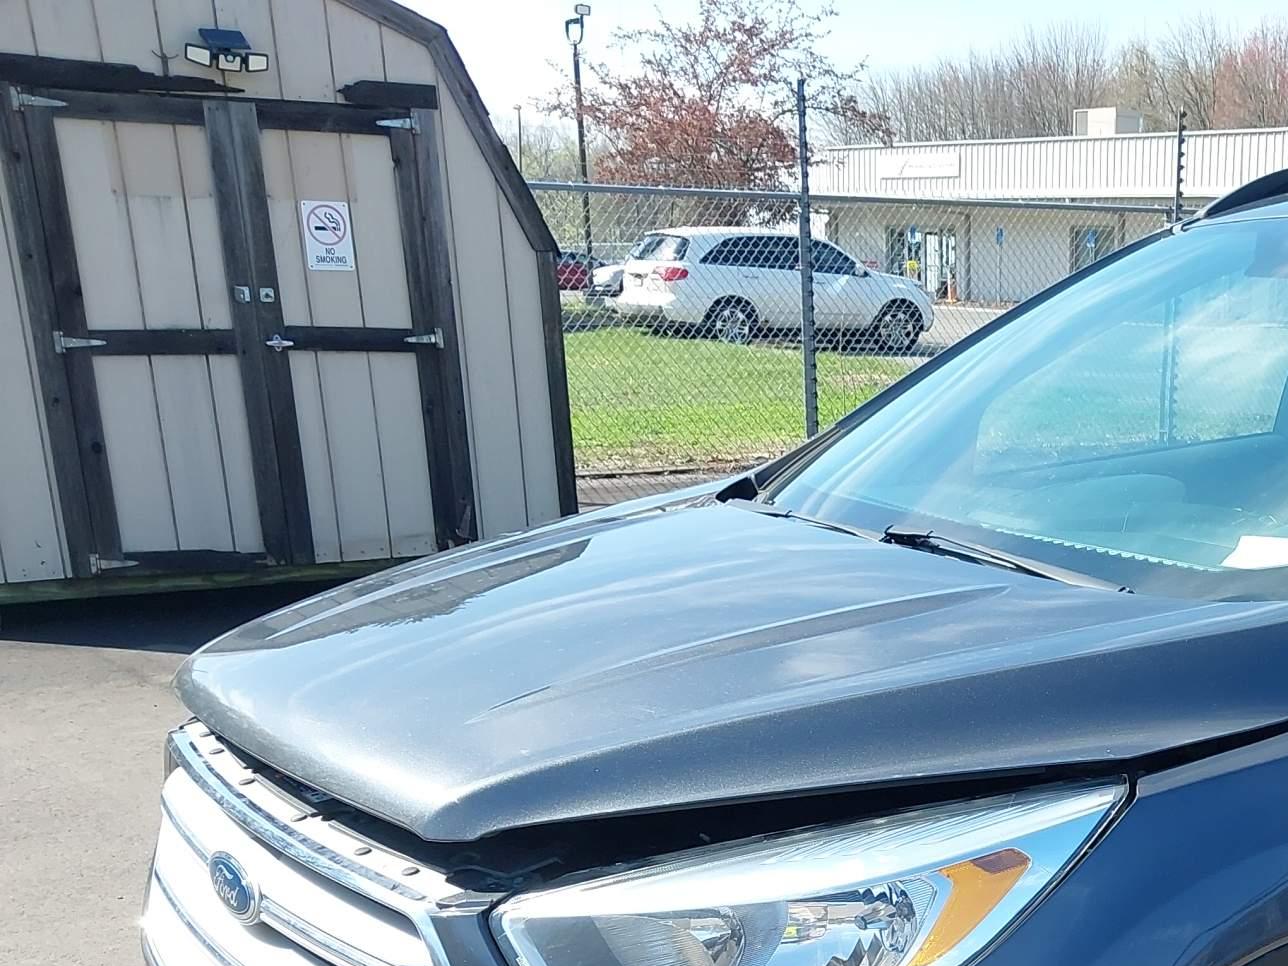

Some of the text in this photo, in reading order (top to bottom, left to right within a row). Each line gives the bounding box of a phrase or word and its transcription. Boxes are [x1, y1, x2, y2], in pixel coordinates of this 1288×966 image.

[325, 247, 336, 255] NO
[315, 255, 347, 264] SMOKING
[213, 864, 239, 906] Ford
